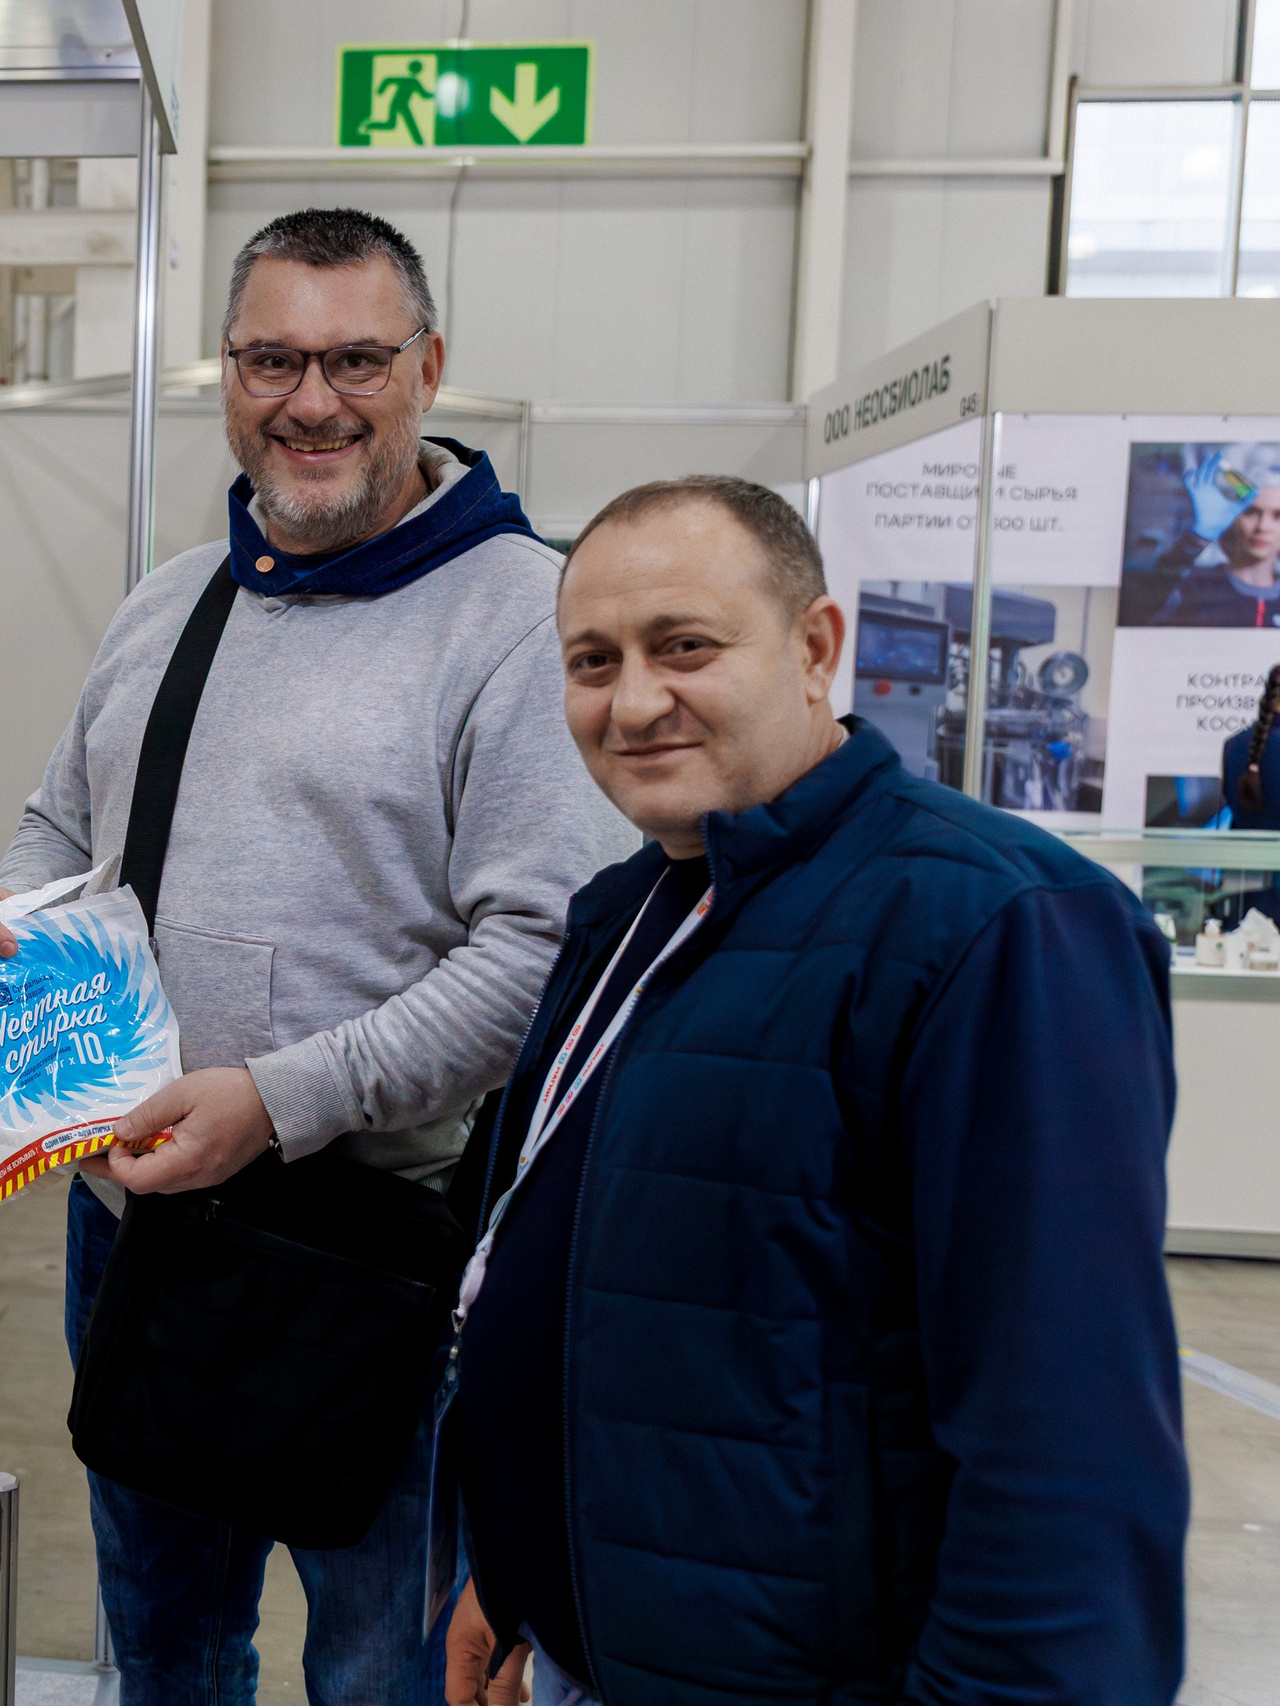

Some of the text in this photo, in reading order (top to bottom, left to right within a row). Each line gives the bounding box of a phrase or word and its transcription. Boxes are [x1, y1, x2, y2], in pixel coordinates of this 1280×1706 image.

[824, 353, 951, 444] ООО НЕОСБИОЛАБ
[922, 463, 1017, 480] МИРОЕ
[866, 482, 1079, 502] ПОСТАВЩИ СЫРЬЯ
[874, 512, 952, 530] ПАРТИИ
[12, 974, 55, 994] Стральй
[4, 1002, 108, 1075] стирка
[68, 1032, 105, 1065] 10
